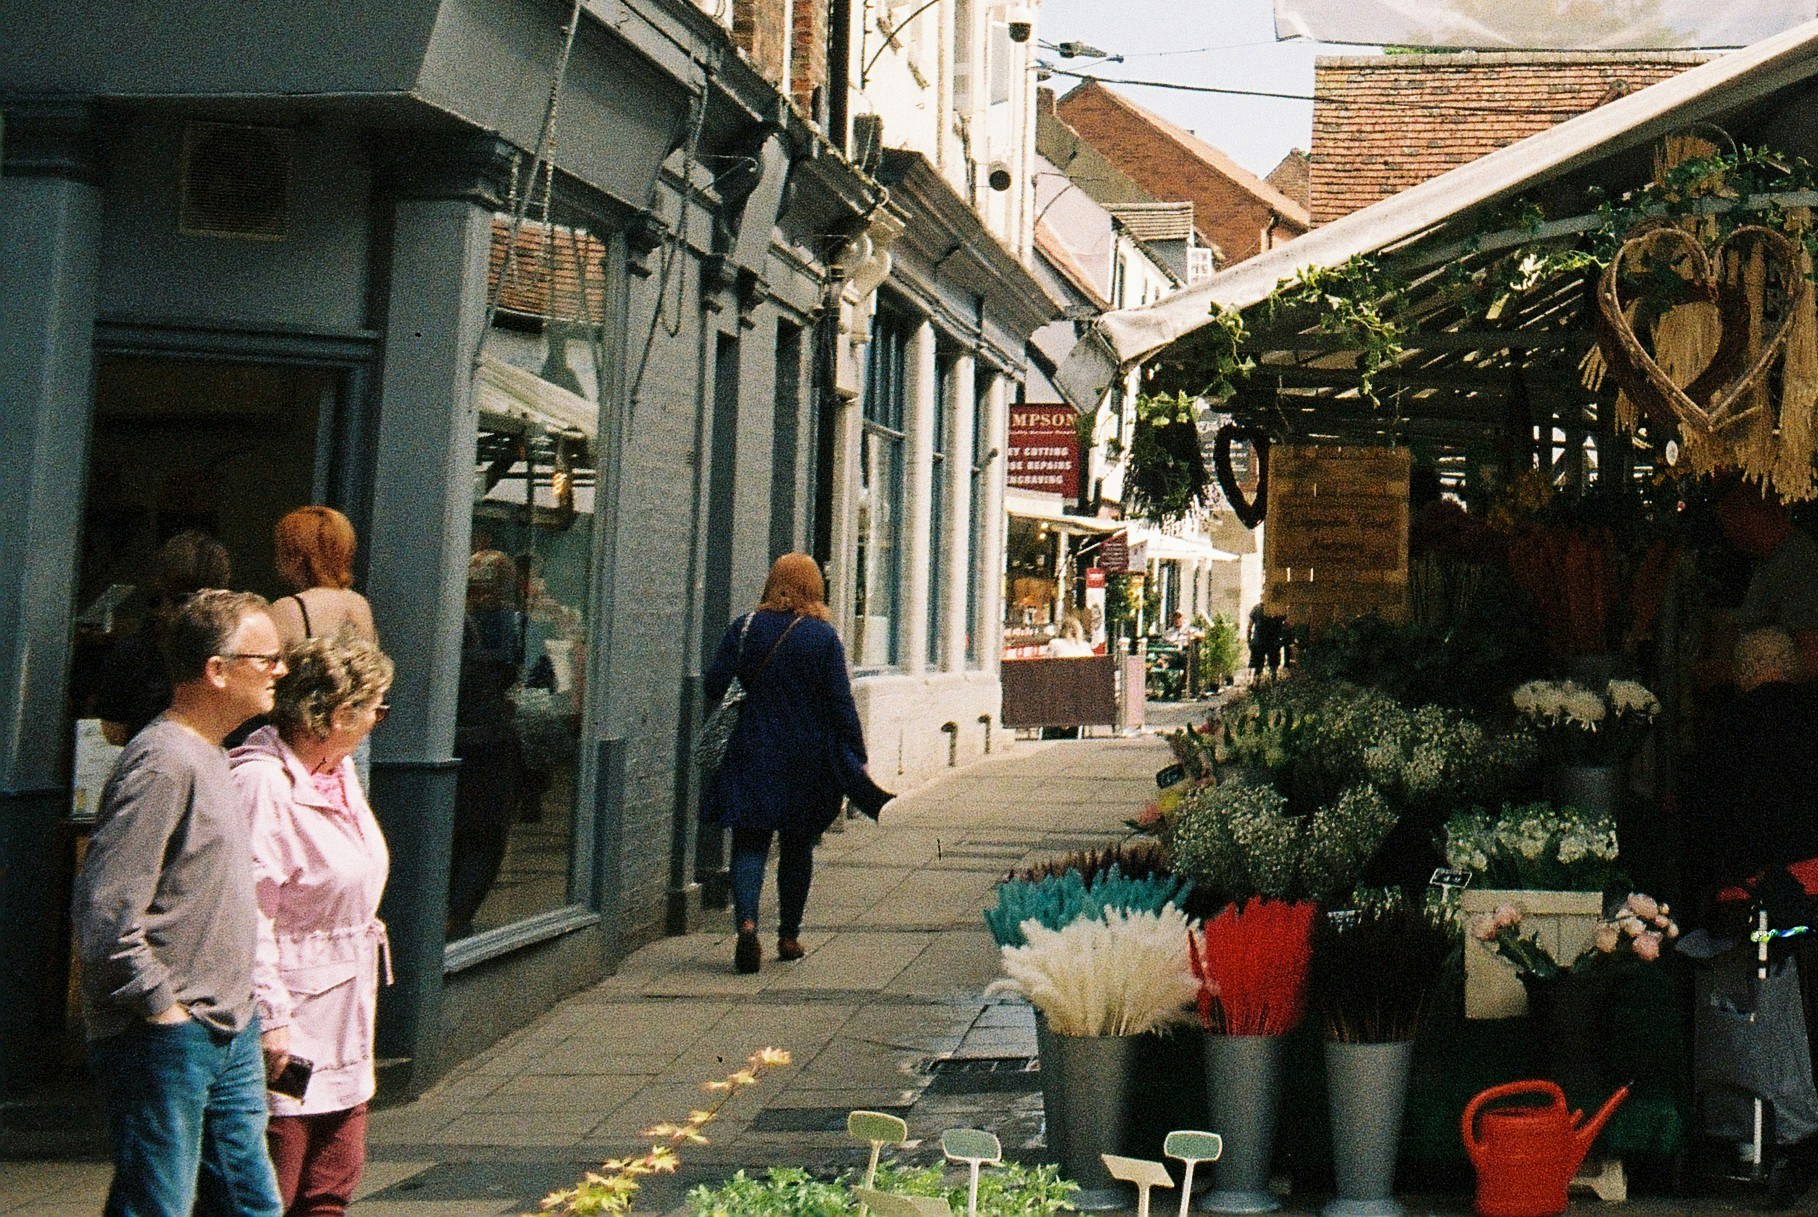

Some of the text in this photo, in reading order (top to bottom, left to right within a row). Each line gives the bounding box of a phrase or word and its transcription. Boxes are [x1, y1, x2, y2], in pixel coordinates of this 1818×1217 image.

[1011, 412, 1078, 428] MPSON
[1008, 446, 1069, 457] EY CUTTING
[1027, 460, 1073, 471] REPAIRS
